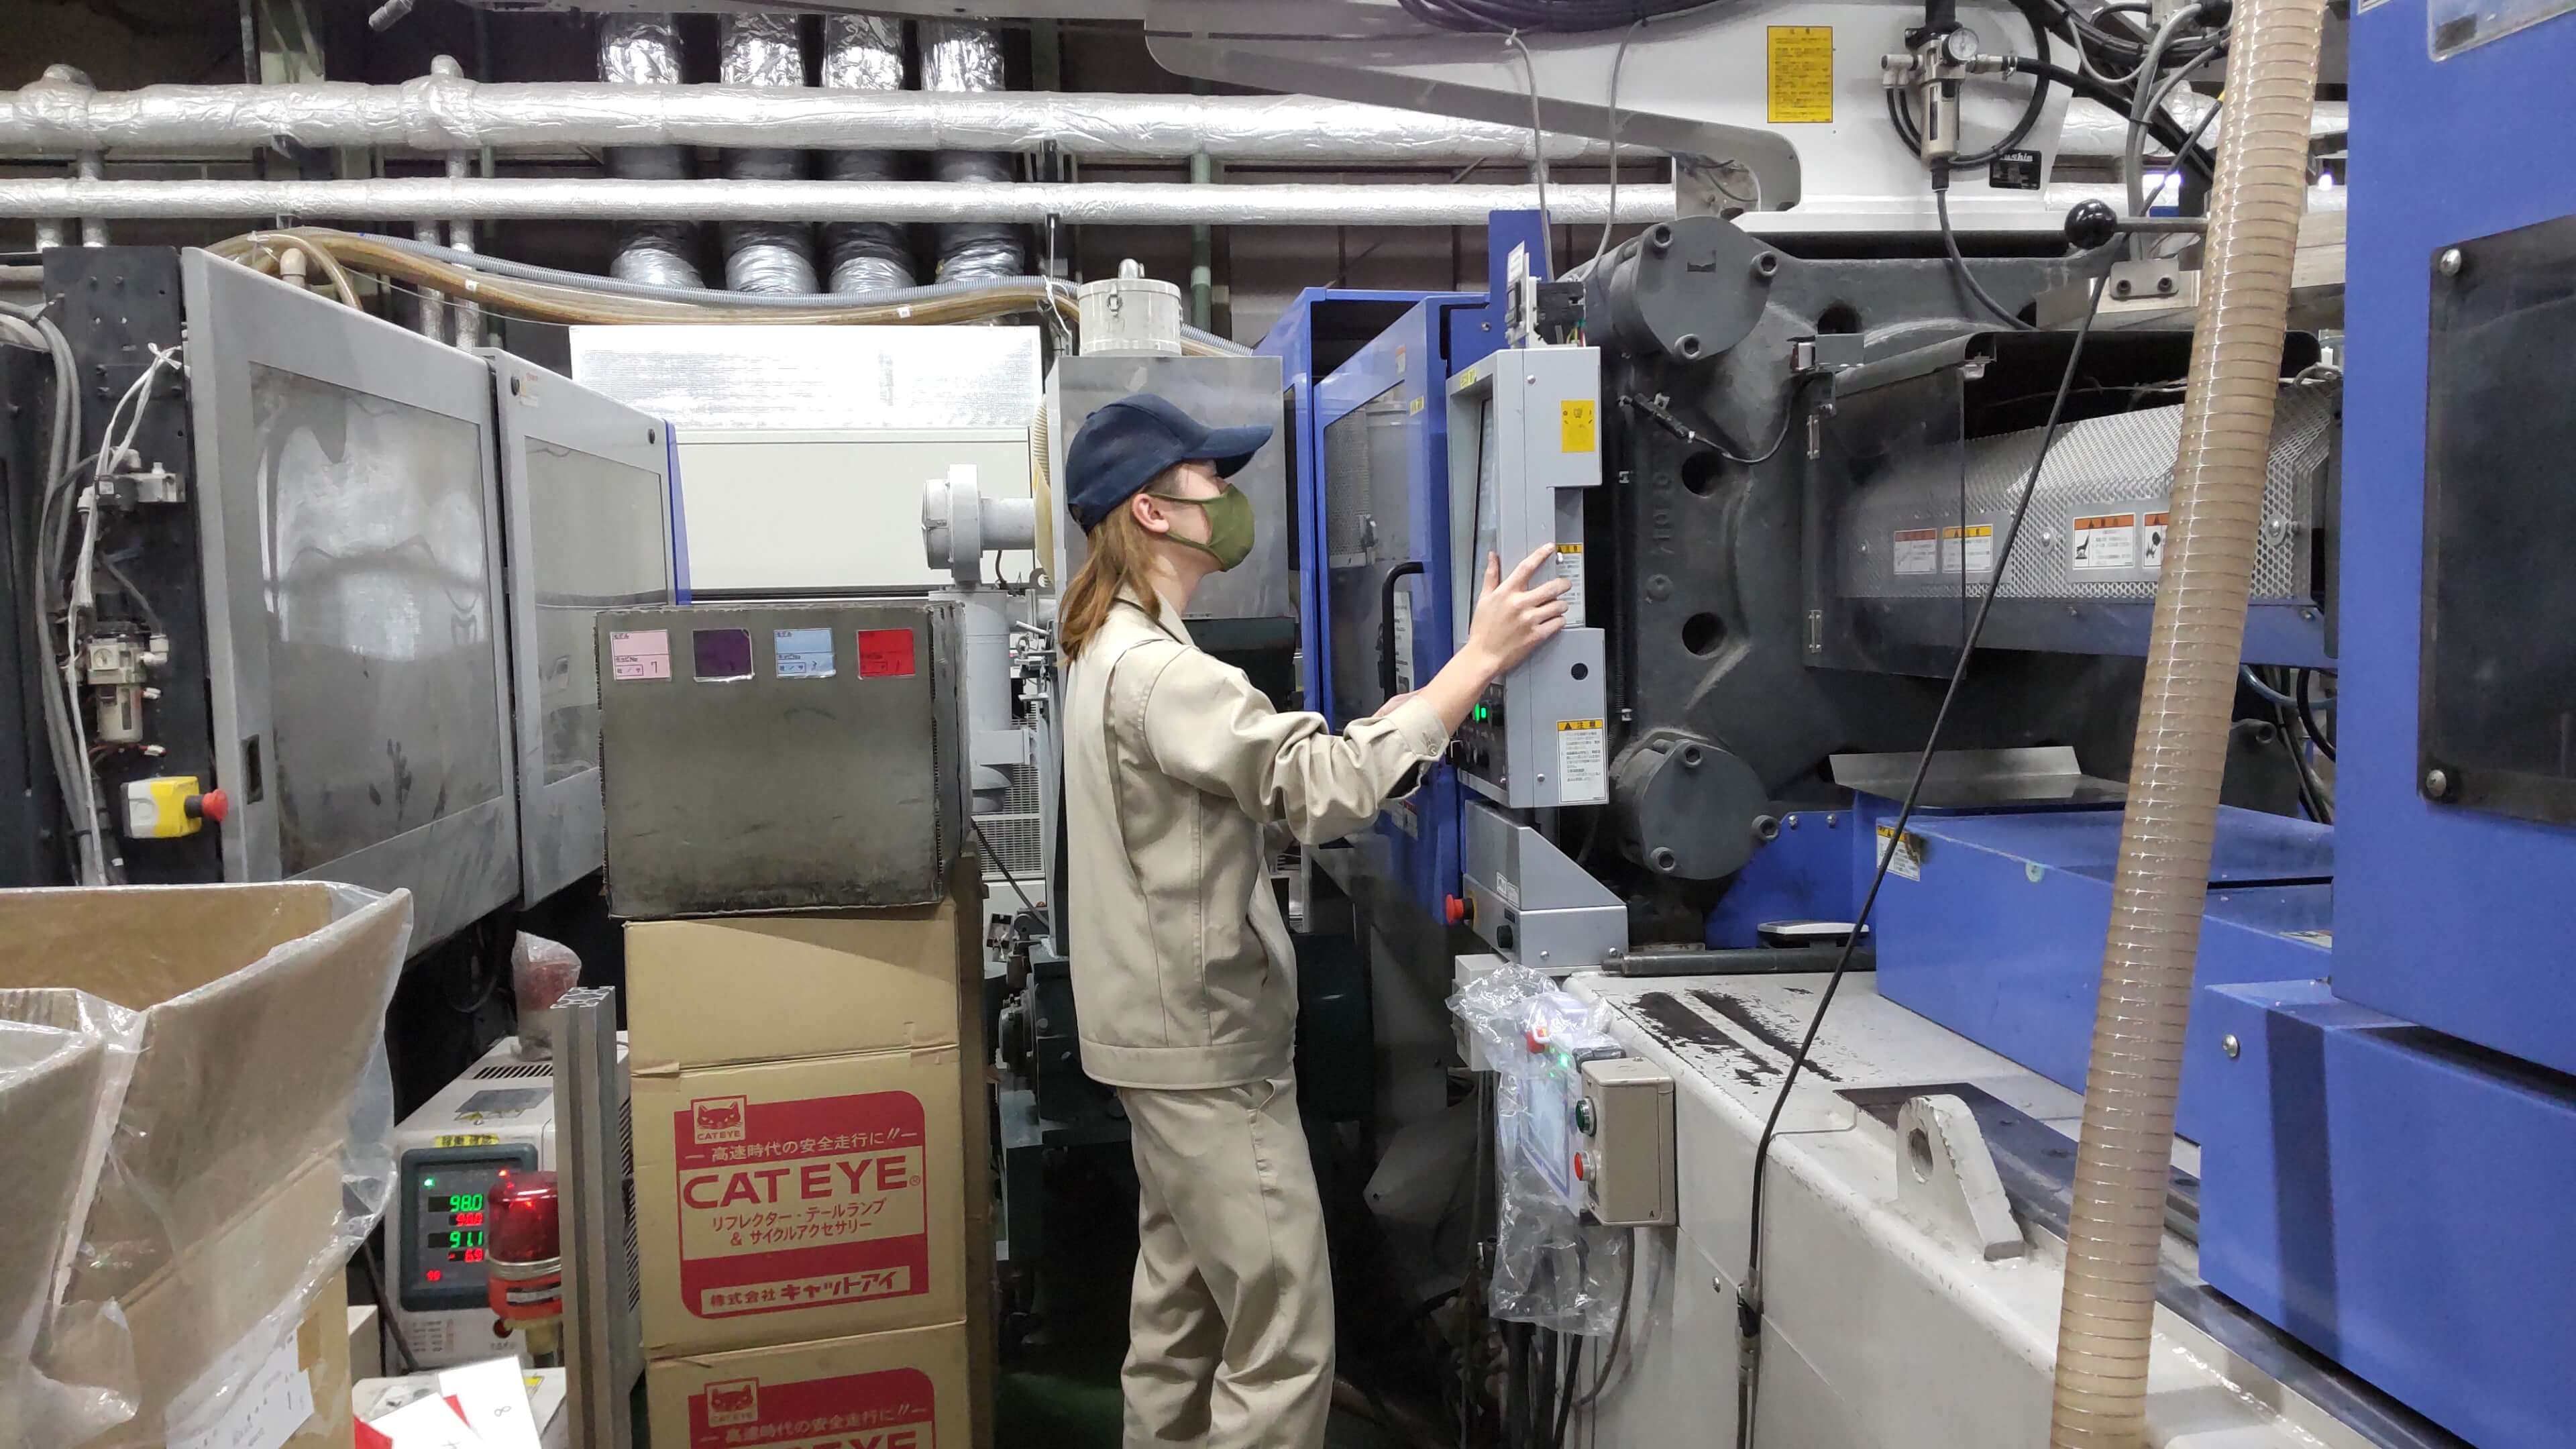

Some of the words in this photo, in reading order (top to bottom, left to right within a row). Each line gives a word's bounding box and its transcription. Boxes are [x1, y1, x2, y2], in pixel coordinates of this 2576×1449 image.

[2000, 152, 2033, 162] ushin
[697, 1130, 741, 1140] CATEYE
[683, 1155, 908, 1209] CATEYE
[730, 1232, 743, 1246] &
[750, 1219, 872, 1246] サイクルアクセサリー
[710, 1289, 776, 1307] 株式会社
[781, 1271, 897, 1301] キャットアイ
